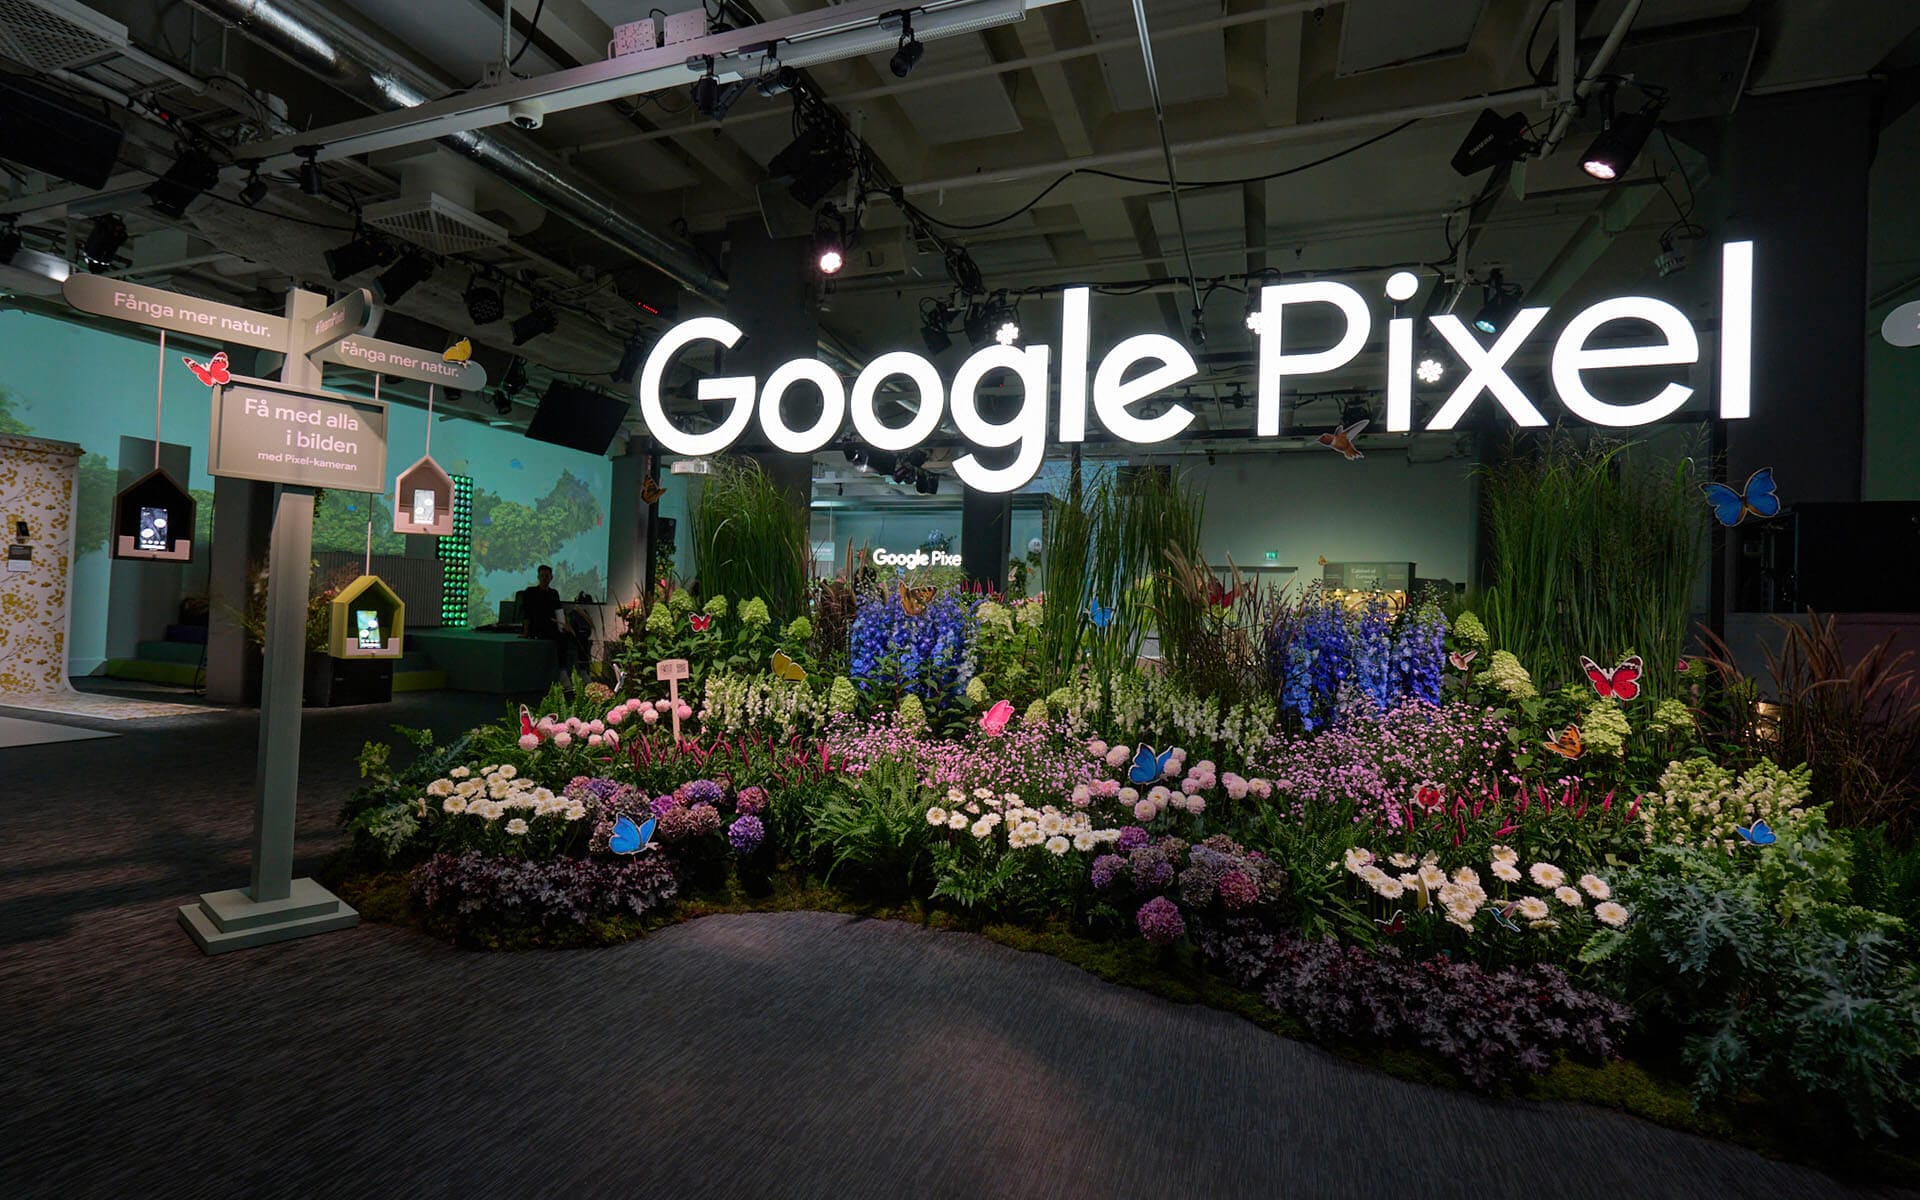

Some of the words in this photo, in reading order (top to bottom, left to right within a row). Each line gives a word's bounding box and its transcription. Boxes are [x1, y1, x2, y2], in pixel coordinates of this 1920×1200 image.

[114, 291, 174, 319] Fånga
[179, 309, 217, 326] mer
[221, 317, 271, 337] natur.
[340, 340, 386, 363] Fånga
[389, 354, 418, 369] mer
[421, 360, 460, 377] natur.
[640, 287, 1198, 493] Google
[1257, 241, 1753, 436] Pixel
[245, 398, 270, 418] Få
[275, 407, 321, 426] med
[326, 413, 359, 431] alla
[286, 429, 291, 446] i
[297, 431, 358, 455] bilden
[257, 452, 283, 463] med
[284, 453, 358, 472] Pixel-kameran
[872, 547, 930, 570] Google
